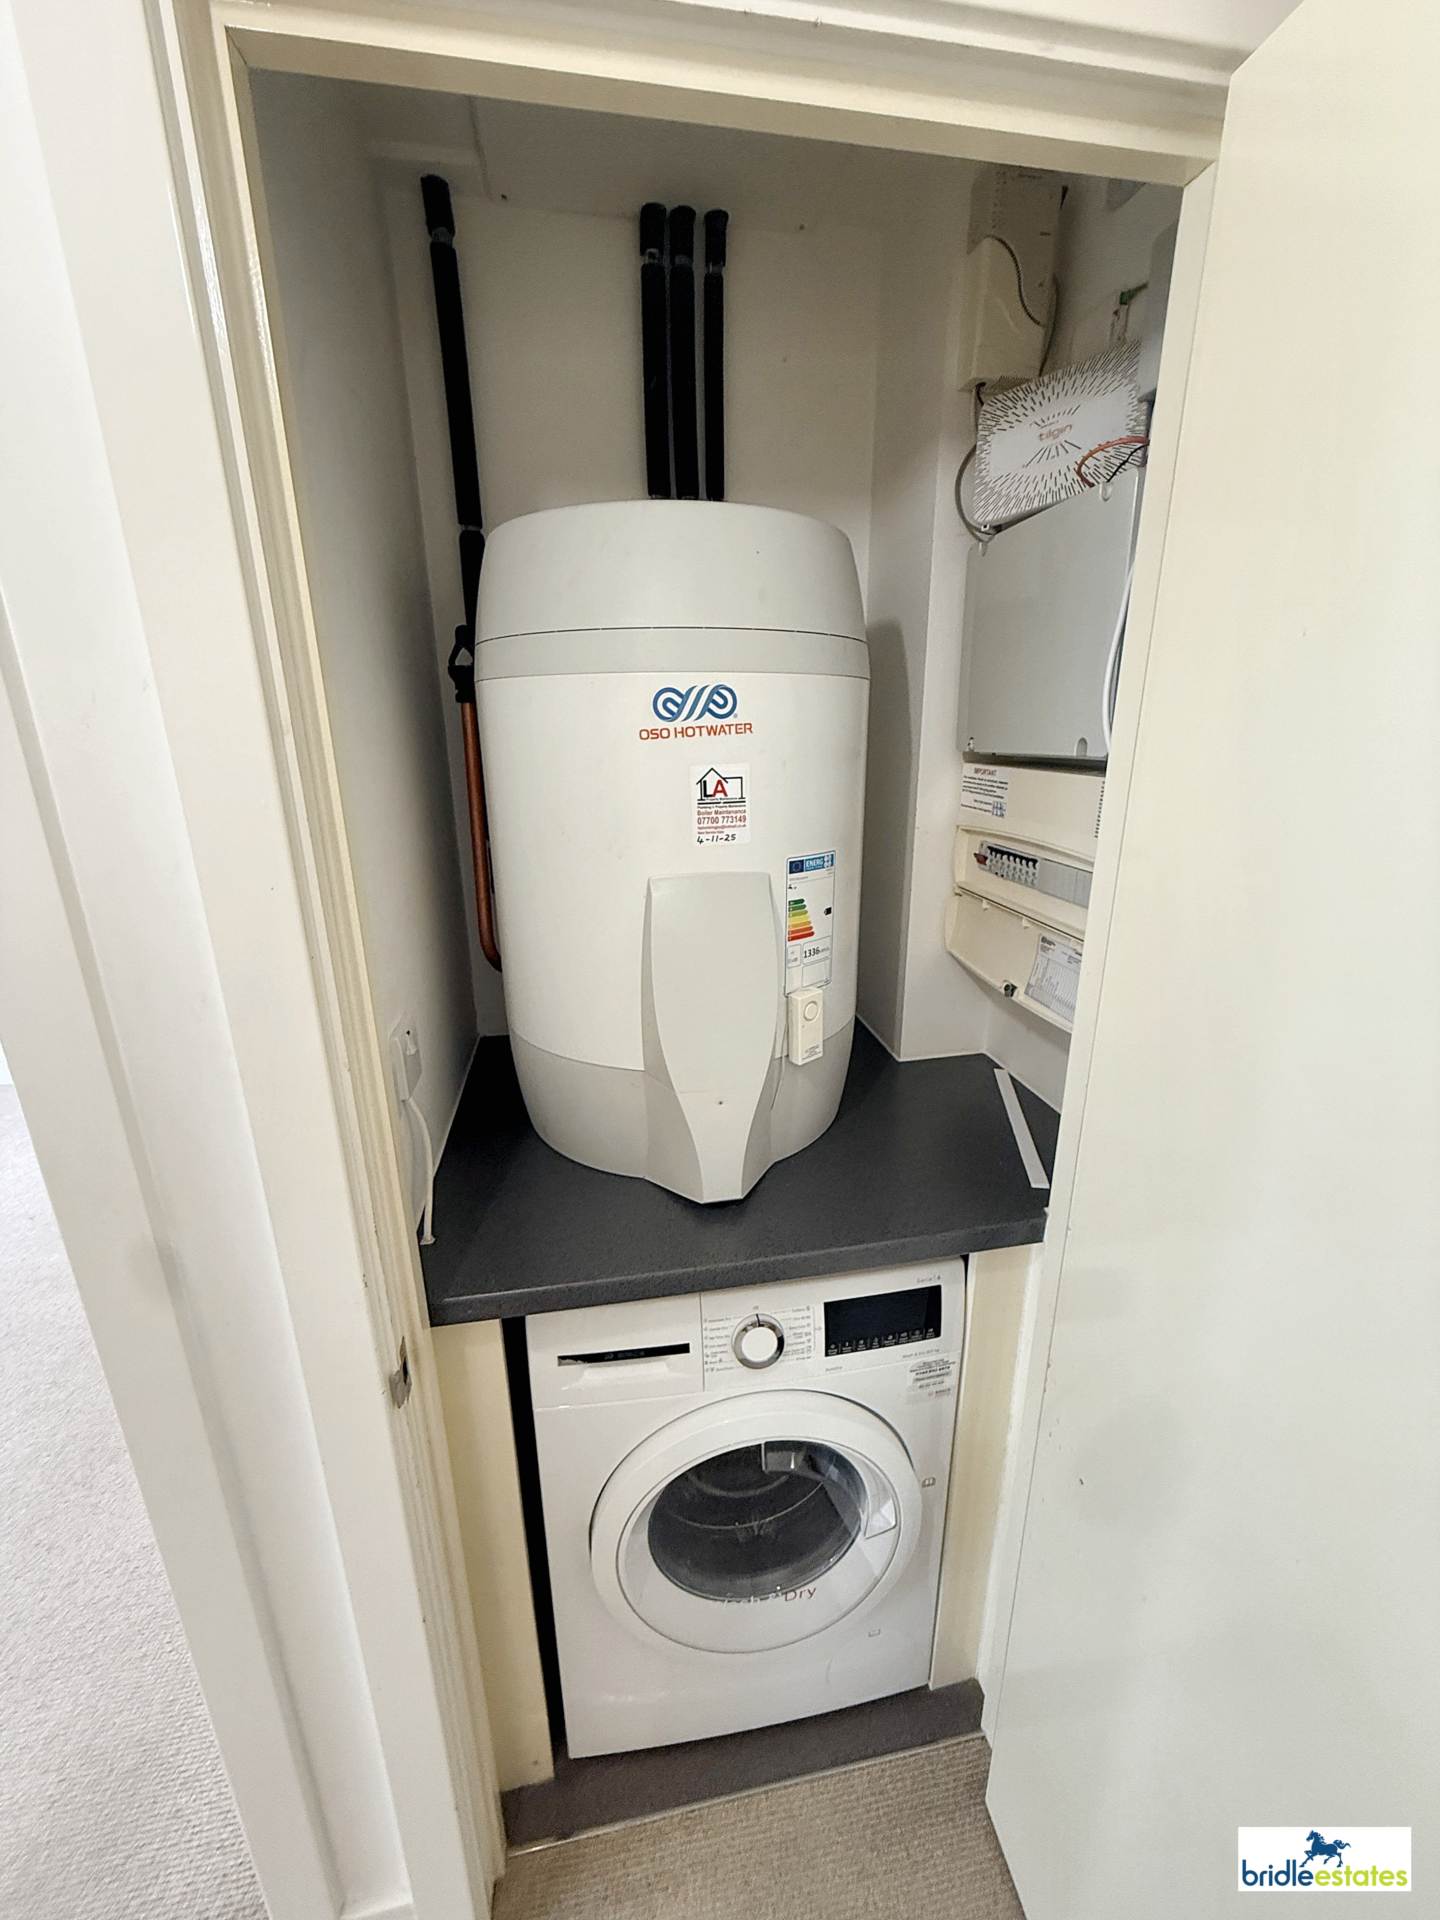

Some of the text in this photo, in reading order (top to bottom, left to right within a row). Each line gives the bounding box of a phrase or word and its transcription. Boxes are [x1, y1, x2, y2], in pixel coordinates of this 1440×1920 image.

[639, 722, 753, 740] OSO HOTWATER
[703, 779, 728, 798] LA
[697, 814, 747, 825] 07700 773149
[697, 833, 737, 845] 4-11-25
[784, 1587, 817, 1602] Dry
